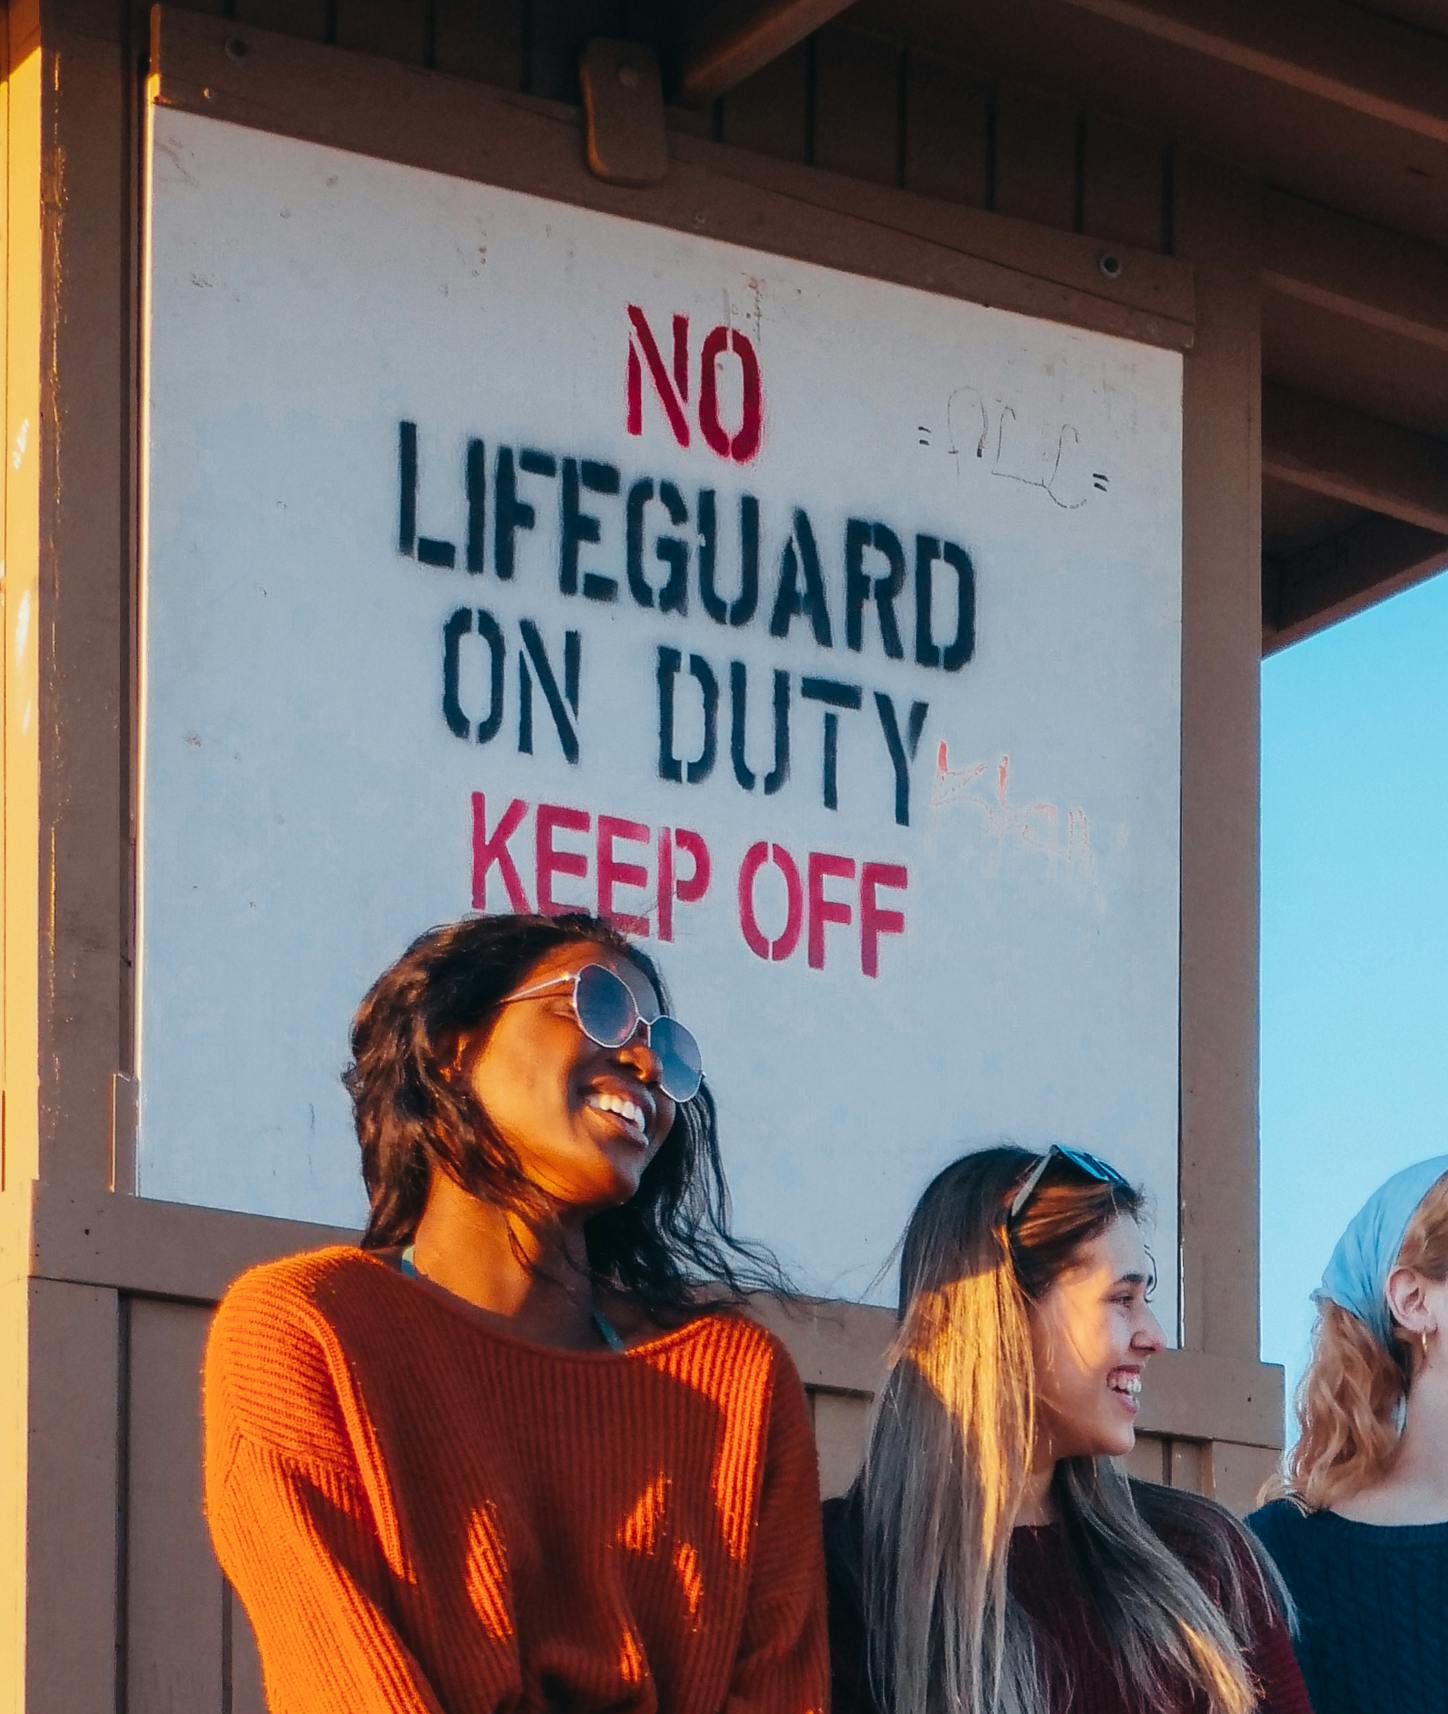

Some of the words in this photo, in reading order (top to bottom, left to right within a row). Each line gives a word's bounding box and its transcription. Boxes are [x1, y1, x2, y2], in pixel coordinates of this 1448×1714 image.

[626, 303, 763, 464] NO
[398, 420, 976, 673] LIFEGUARD
[441, 606, 581, 765] ON
[656, 644, 930, 827] DUTY
[470, 790, 711, 943] KEEP
[737, 839, 909, 979] OFF
